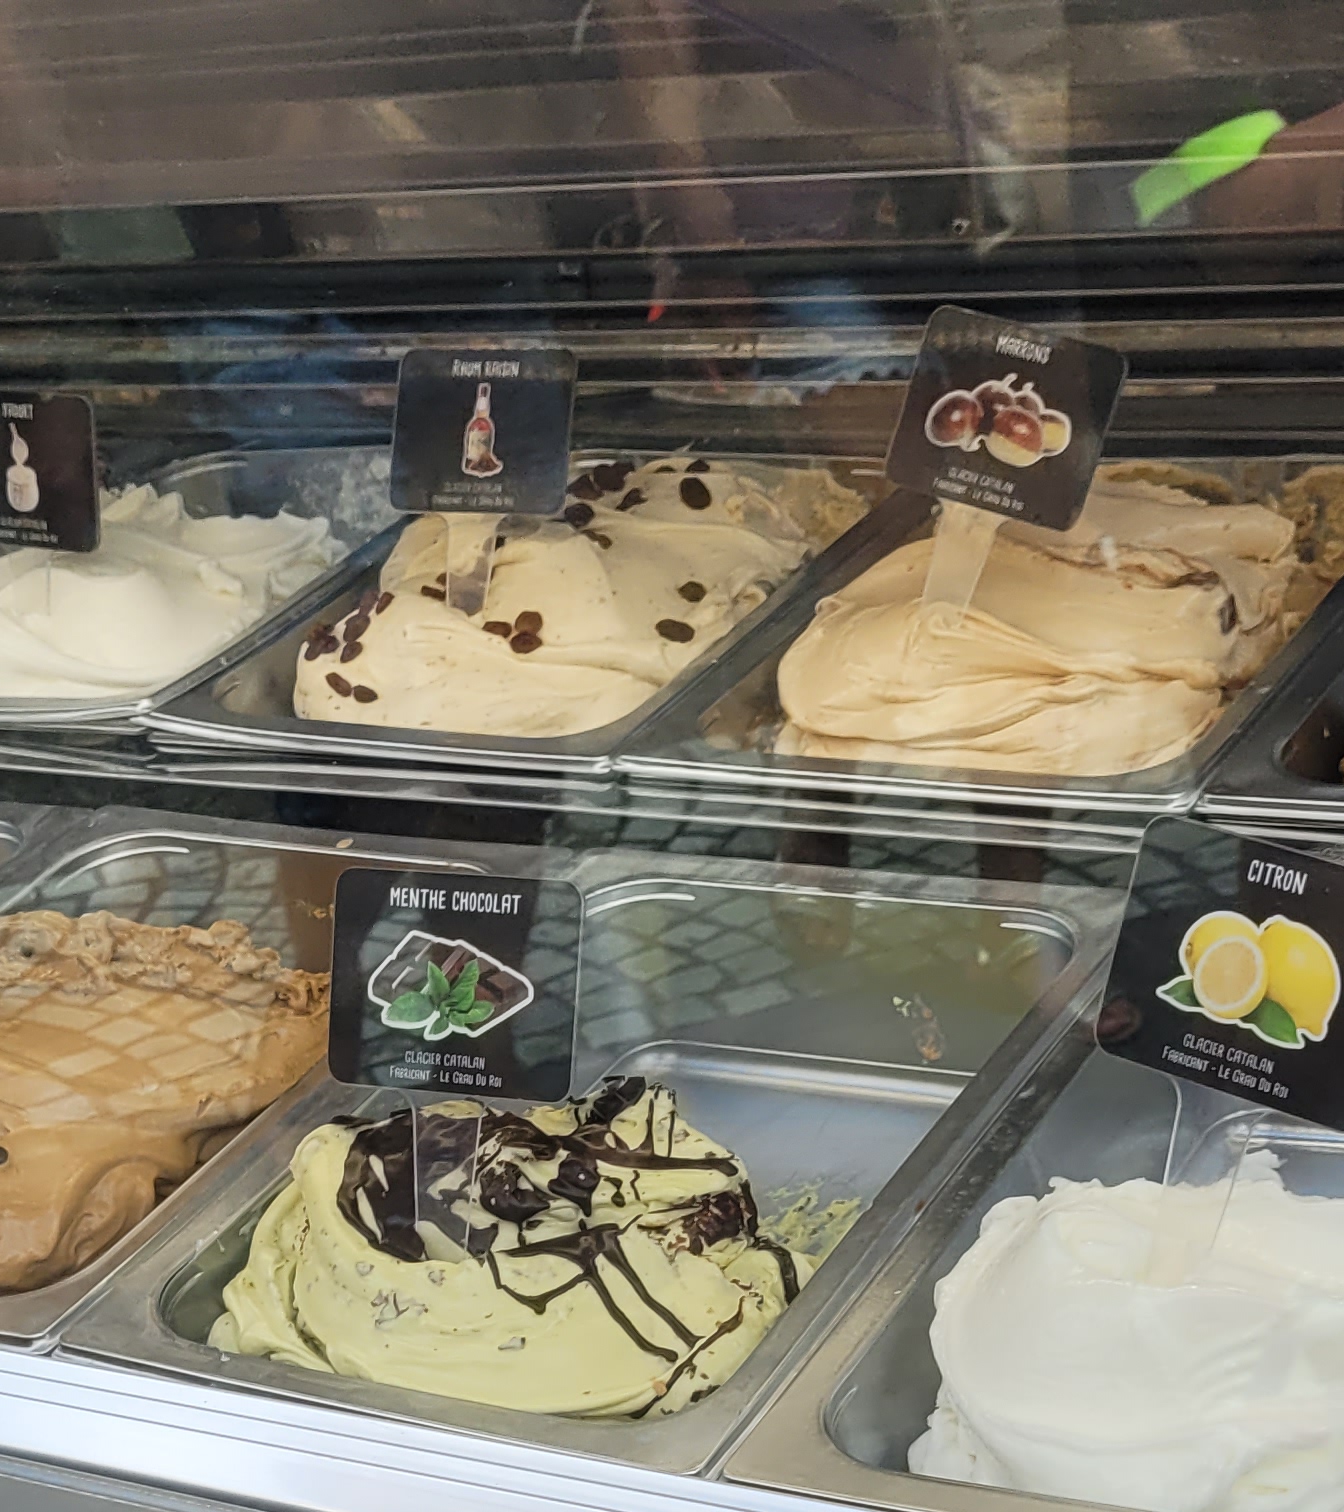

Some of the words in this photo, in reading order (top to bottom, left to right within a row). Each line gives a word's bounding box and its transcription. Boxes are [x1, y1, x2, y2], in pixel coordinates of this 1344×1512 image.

[1246, 859, 1309, 896] CITRON
[389, 886, 447, 911] MENTHE
[451, 890, 523, 916] CHOCOLAT
[404, 1050, 442, 1066] GLACIER
[443, 1053, 486, 1071] CATALAN
[1182, 1033, 1226, 1059] GLACIER
[1226, 1047, 1275, 1075] CATALAN
